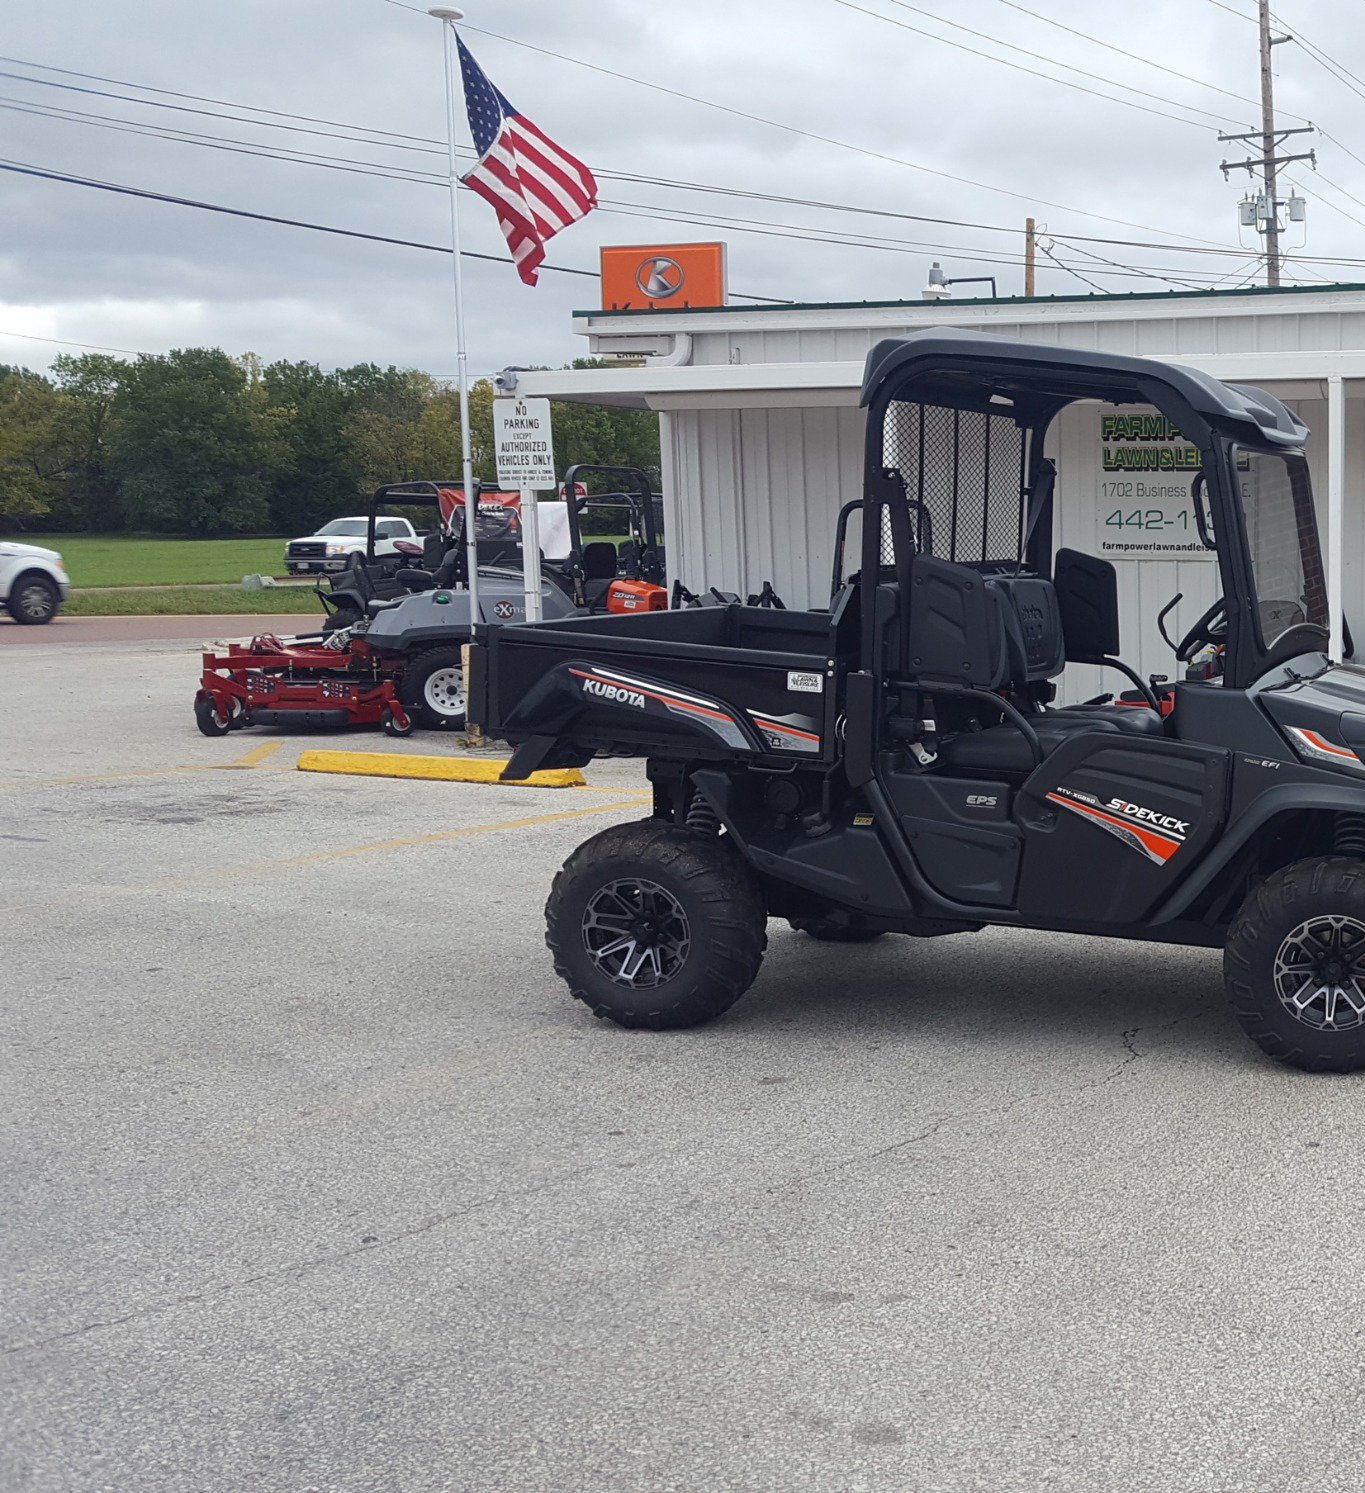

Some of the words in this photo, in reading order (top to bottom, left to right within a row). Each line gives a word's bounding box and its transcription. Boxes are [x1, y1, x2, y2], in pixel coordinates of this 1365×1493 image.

[515, 405, 527, 415] NO
[504, 418, 540, 429] PARKING
[1101, 414, 1165, 441] FARM
[513, 432, 532, 440] EXCEPT
[500, 441, 547, 452] AUTHORIZED
[498, 454, 530, 466] VEHICLES
[532, 454, 551, 466] ONLY
[1102, 447, 1157, 472] LAWN
[1159, 447, 1175, 472] &
[1102, 482, 1133, 498] 1702
[1136, 482, 1187, 498] Business
[582, 678, 646, 709] KUBOTA
[1261, 760, 1280, 769] EFI
[965, 794, 998, 806] EPS
[1056, 786, 1096, 804] RTV-XG850
[1105, 797, 1191, 834] SIDEKICK
